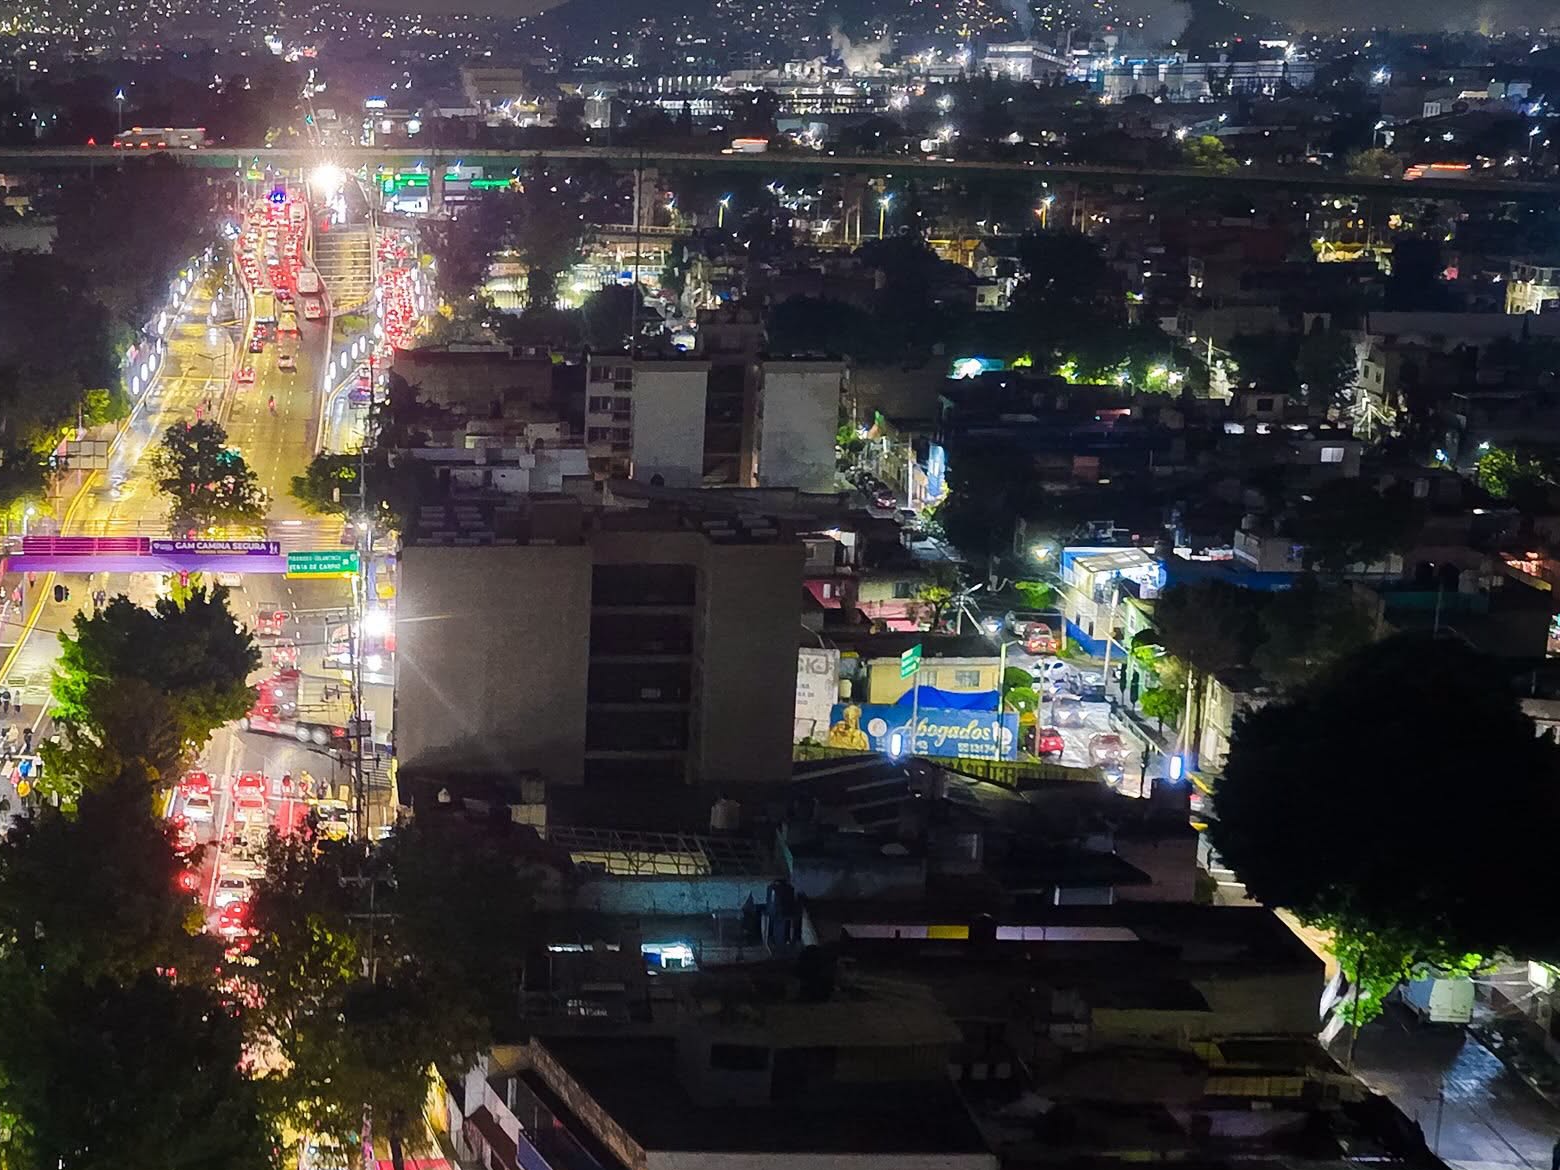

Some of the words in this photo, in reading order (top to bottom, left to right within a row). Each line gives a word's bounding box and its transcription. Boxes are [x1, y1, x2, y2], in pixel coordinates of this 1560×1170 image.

[196, 542, 231, 550] CAMINA
[232, 542, 266, 550] SEGURA
[898, 717, 991, 747] Abogados
